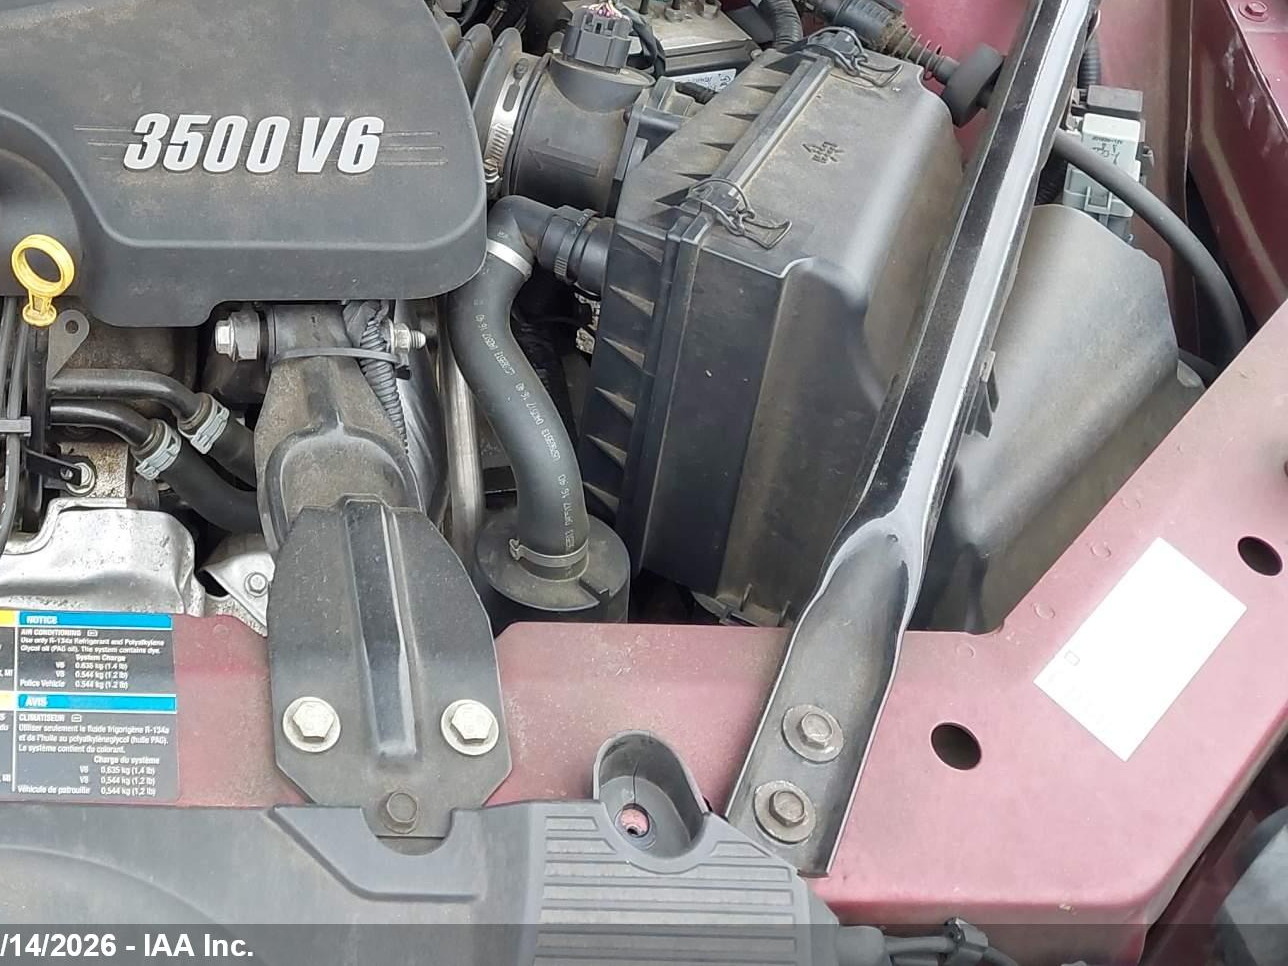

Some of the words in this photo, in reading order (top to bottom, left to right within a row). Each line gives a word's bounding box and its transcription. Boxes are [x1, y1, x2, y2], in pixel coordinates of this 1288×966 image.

[123, 113, 290, 173] 3500
[297, 116, 385, 174] V6
[27, 616, 57, 624] NOTICE
[25, 697, 47, 706] AVIS
